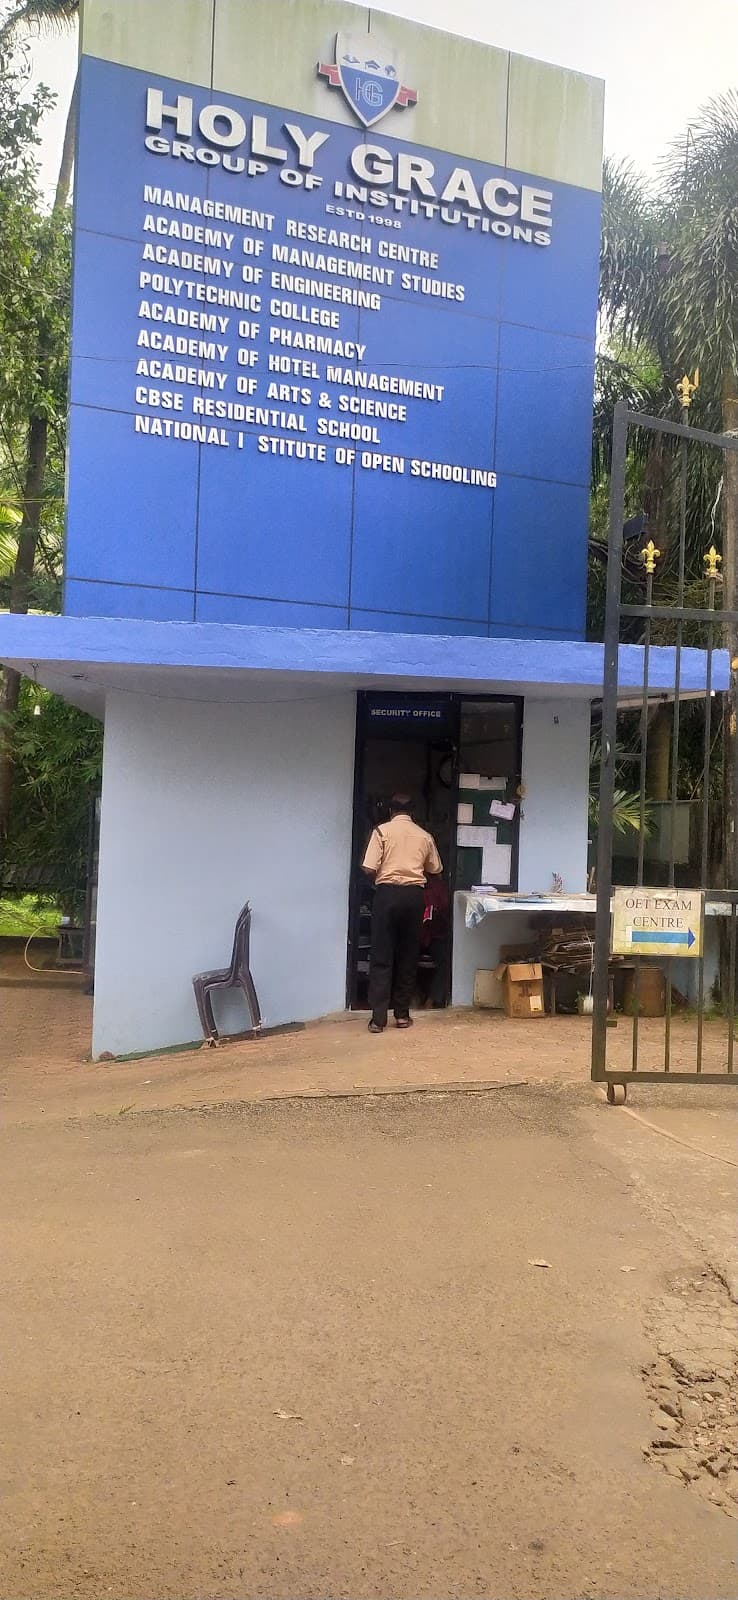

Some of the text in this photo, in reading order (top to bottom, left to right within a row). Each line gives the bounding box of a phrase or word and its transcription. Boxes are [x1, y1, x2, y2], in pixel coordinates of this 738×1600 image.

[146, 87, 554, 227] HOLY GRACE
[144, 135, 551, 247] GROUP OF INSTITUTIONS
[325, 203, 402, 229] ESTD 1998
[143, 214, 465, 302] ACADEMY OF MANAGEMENT STUDIES
[144, 185, 440, 270] MANAGEMENT RESEARCH CENTRE
[139, 271, 340, 329] POLYTECHNIC COLLEGE
[142, 243, 381, 311] ACADEMY OF ENGINEERING
[139, 301, 366, 361] ACADEMY OF PHARMACY
[136, 358, 406, 422] ACADEMY OF ARTS & SCIENCE
[137, 330, 444, 402] ACADEMY OF HOTEL MANAGEMENT
[136, 386, 380, 444] CBSE RESIDENTIAL SCHOOL
[135, 415, 229, 447] NATIONAL
[336, 448, 355, 466] OF
[362, 452, 404, 474] OPEN
[411, 460, 497, 488] SCHOOLING
[370, 709, 441, 718] SECURITY OFFICE
[625, 898, 692, 911] OET EXAM
[632, 916, 684, 928] CENTRE
